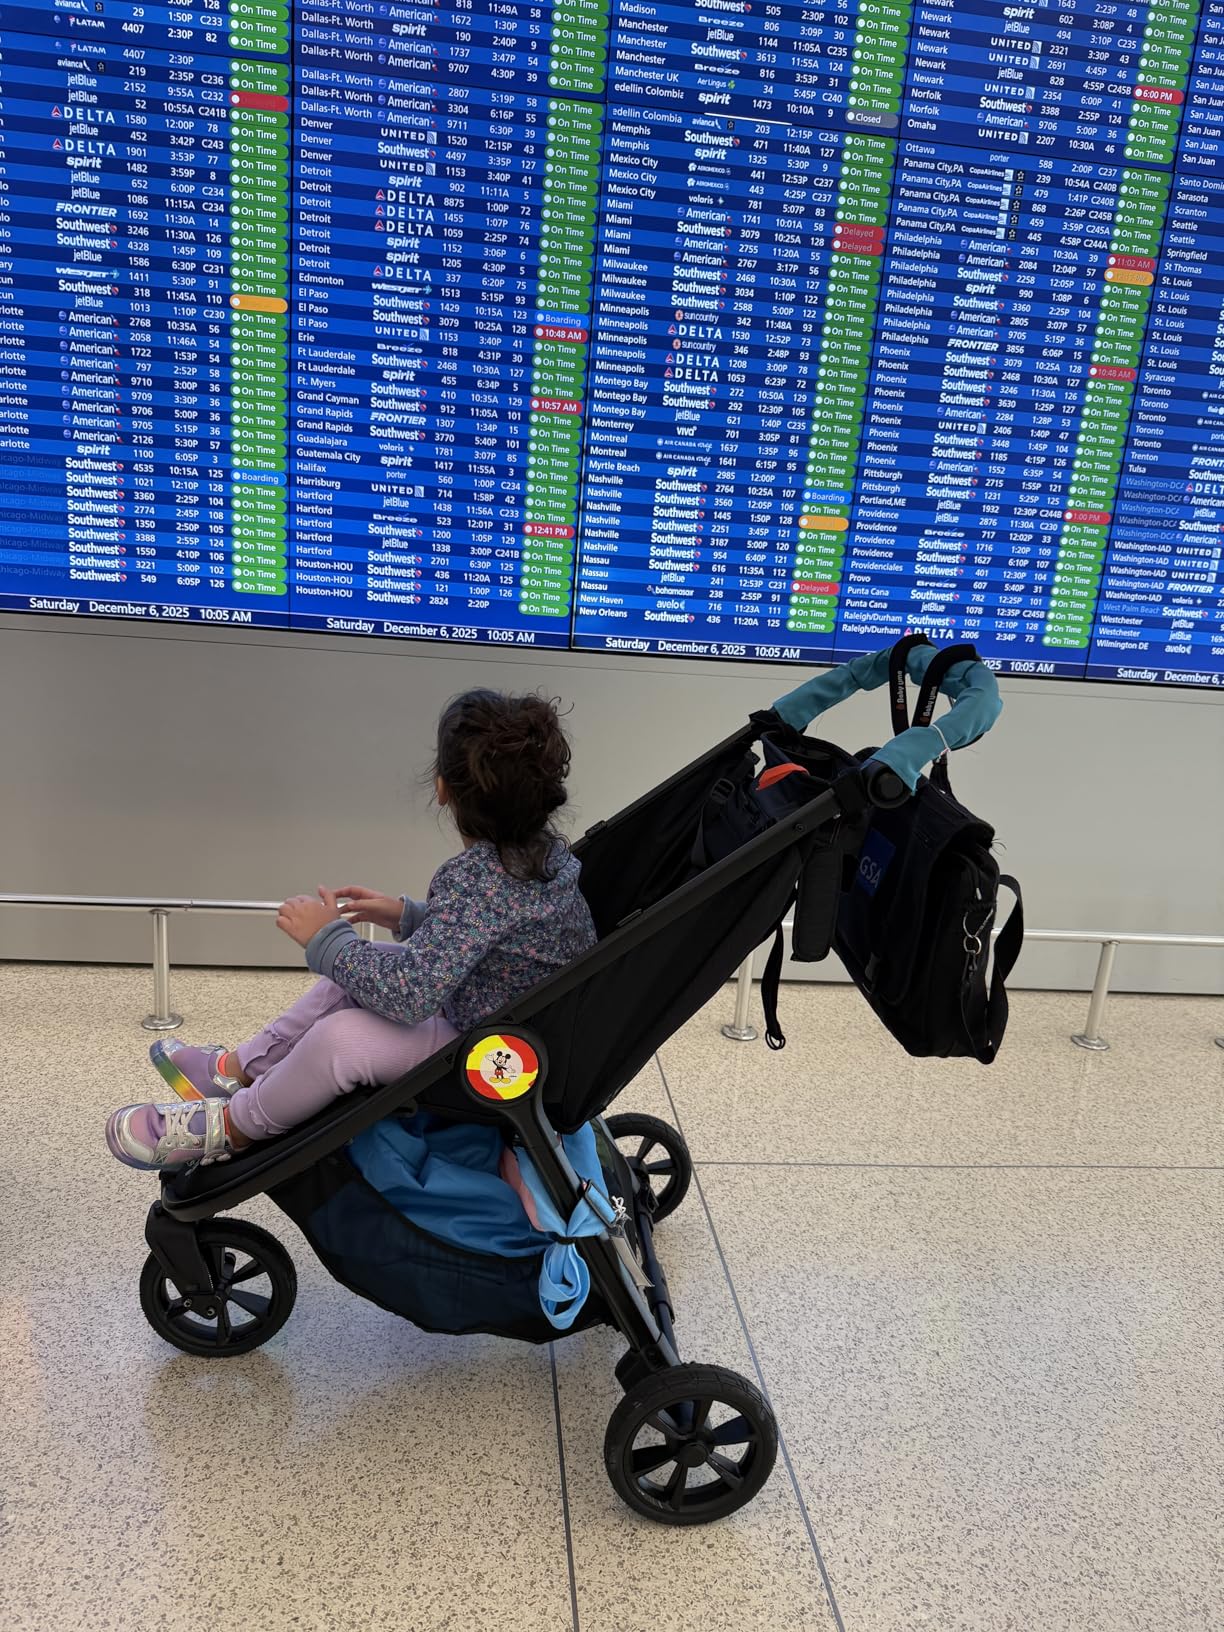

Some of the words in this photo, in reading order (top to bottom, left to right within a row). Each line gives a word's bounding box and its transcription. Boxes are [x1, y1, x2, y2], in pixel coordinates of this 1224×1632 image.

[122, 23, 144, 33] 4407
[168, 28, 193, 39] 2:30P
[206, 33, 216, 42] 82
[302, 12, 342, 25] Dallas-Ft.
[345, 17, 373, 29] Worth
[392, 24, 426, 36] spirit
[456, 32, 470, 41] 190
[493, 36, 516, 47] 2:40P
[531, 41, 536, 50] 9
[562, 29, 574, 38] On
[576, 31, 596, 41] Time
[921, 11, 952, 23] Newark
[1003, 7, 1034, 18] spirit
[1059, 15, 1073, 24] 602
[1093, 20, 1114, 30] 3:08P
[1154, 28, 1164, 37] On
[1167, 31, 1184, 40] Time
[619, 18, 668, 32] Manchester
[707, 28, 734, 41] jetBlue
[758, 37, 778, 48] 1144
[793, 41, 821, 54] 11:05A
[827, 46, 847, 56] C235
[914, 73, 944, 84] Newark
[984, 84, 1024, 96] UNITED
[1043, 91, 1061, 100] 2354
[1081, 96, 1102, 106] 6:00P
[1112, 100, 1121, 108] 41
[64, 107, 115, 124] DELTA
[126, 115, 146, 125] 1580
[166, 119, 194, 130] 12:00P
[208, 124, 218, 132] 78
[241, 128, 254, 137] On
[256, 130, 276, 139] Time
[856, 113, 881, 124] Closed
[301, 118, 332, 129] Denver
[381, 128, 425, 141] UNITED
[448, 136, 467, 146] 1520
[485, 140, 512, 151] 12:15P
[524, 145, 534, 154] 43
[300, 181, 331, 192] Detroit
[387, 190, 434, 206] DELTA
[444, 198, 464, 207] 8875
[487, 202, 509, 212] 1:00P
[521, 206, 530, 215] 72
[56, 203, 116, 217] FRONTIER
[128, 210, 148, 220] 1692
[165, 214, 195, 226] 11:30A
[209, 219, 218, 227] 14
[894, 232, 942, 245] Philadelphia
[968, 240, 1006, 252] American
[1021, 246, 1038, 255] 2961
[1054, 250, 1078, 260] 10:30A
[1089, 254, 1098, 262] 39
[1167, 248, 1207, 260] Springfield
[69, 311, 112, 325] American
[130, 318, 151, 327] 2768
[168, 321, 196, 331] 10:35A
[209, 325, 219, 333] 56
[299, 303, 306, 311] El
[309, 304, 328, 313] Paso
[373, 310, 423, 325] Southwest
[439, 318, 459, 327] 3079
[475, 321, 502, 331] 10:25A
[512, 325, 526, 334] 128
[545, 329, 565, 339] 10:48
[567, 331, 582, 340] AM
[1155, 318, 1164, 326] St.
[1166, 320, 1184, 328] Louis
[298, 363, 304, 372] Ft
[307, 364, 355, 376] Lauderdale
[383, 370, 415, 381] spirit
[597, 347, 646, 359] Minneapolis
[676, 354, 719, 367] DELTA
[729, 360, 747, 368] 1208
[766, 363, 787, 372] 3:00P
[798, 366, 808, 374] 78
[878, 360, 909, 370] Phoenix
[943, 366, 987, 379] Southwest
[1145, 372, 1175, 382] Syracuse
[297, 448, 342, 460] Guatemala
[344, 453, 360, 463] City
[381, 456, 412, 466] spirit
[435, 461, 453, 470] 1417
[469, 464, 495, 474] 11:55A
[588, 474, 623, 484] Nashville
[656, 479, 700, 492] Southwest
[716, 485, 734, 493] 2764
[748, 487, 773, 496] 10:25A
[783, 490, 795, 498] 107
[812, 492, 844, 503] Boarding
[296, 532, 332, 542] Hartford
[382, 537, 408, 548] jetBlue
[432, 544, 450, 552] 1338
[470, 547, 492, 556] 3:00P
[495, 549, 519, 558] C241B
[1115, 541, 1172, 552] Washington-IAD
[1176, 547, 1211, 556] UNITED
[582, 568, 608, 577] Nassau
[661, 572, 685, 583] jetBlue
[800, 584, 829, 592] Delayed
[296, 586, 352, 597] Houston-HOU
[367, 591, 415, 604] Southwest
[430, 596, 448, 605] 2824
[468, 600, 489, 608] 2:20P
[30, 598, 79, 612] Saturday
[90, 602, 146, 616] December
[162, 606, 189, 617] 2025
[200, 609, 229, 620] 10:05
[232, 611, 251, 622] AM
[580, 608, 596, 616] New
[599, 608, 627, 618] Orleans
[644, 610, 688, 622] Southwest
[734, 617, 758, 625] 11:20A
[327, 619, 374, 633] Saturday
[384, 622, 438, 636] December
[452, 628, 477, 638] 2025
[488, 630, 514, 641] 10:05
[516, 632, 534, 642] AM
[842, 625, 900, 635] Raleigh/Durham
[1099, 628, 1140, 637] Westchester
[1169, 631, 1192, 640] jetBlue
[606, 638, 650, 650] Saturday
[658, 641, 709, 653] December
[722, 645, 745, 655] 2025
[755, 647, 780, 657] 10:05
[782, 648, 800, 658] AM
[1096, 640, 1136, 650] Wilmington
[1138, 642, 1149, 650] DE
[983, 660, 1001, 670] 025
[1010, 662, 1035, 672] 10:05
[1036, 664, 1054, 673] AM
[1117, 668, 1157, 681] Saturday
[1164, 672, 1211, 683] December
[860, 856, 881, 888] GSA
